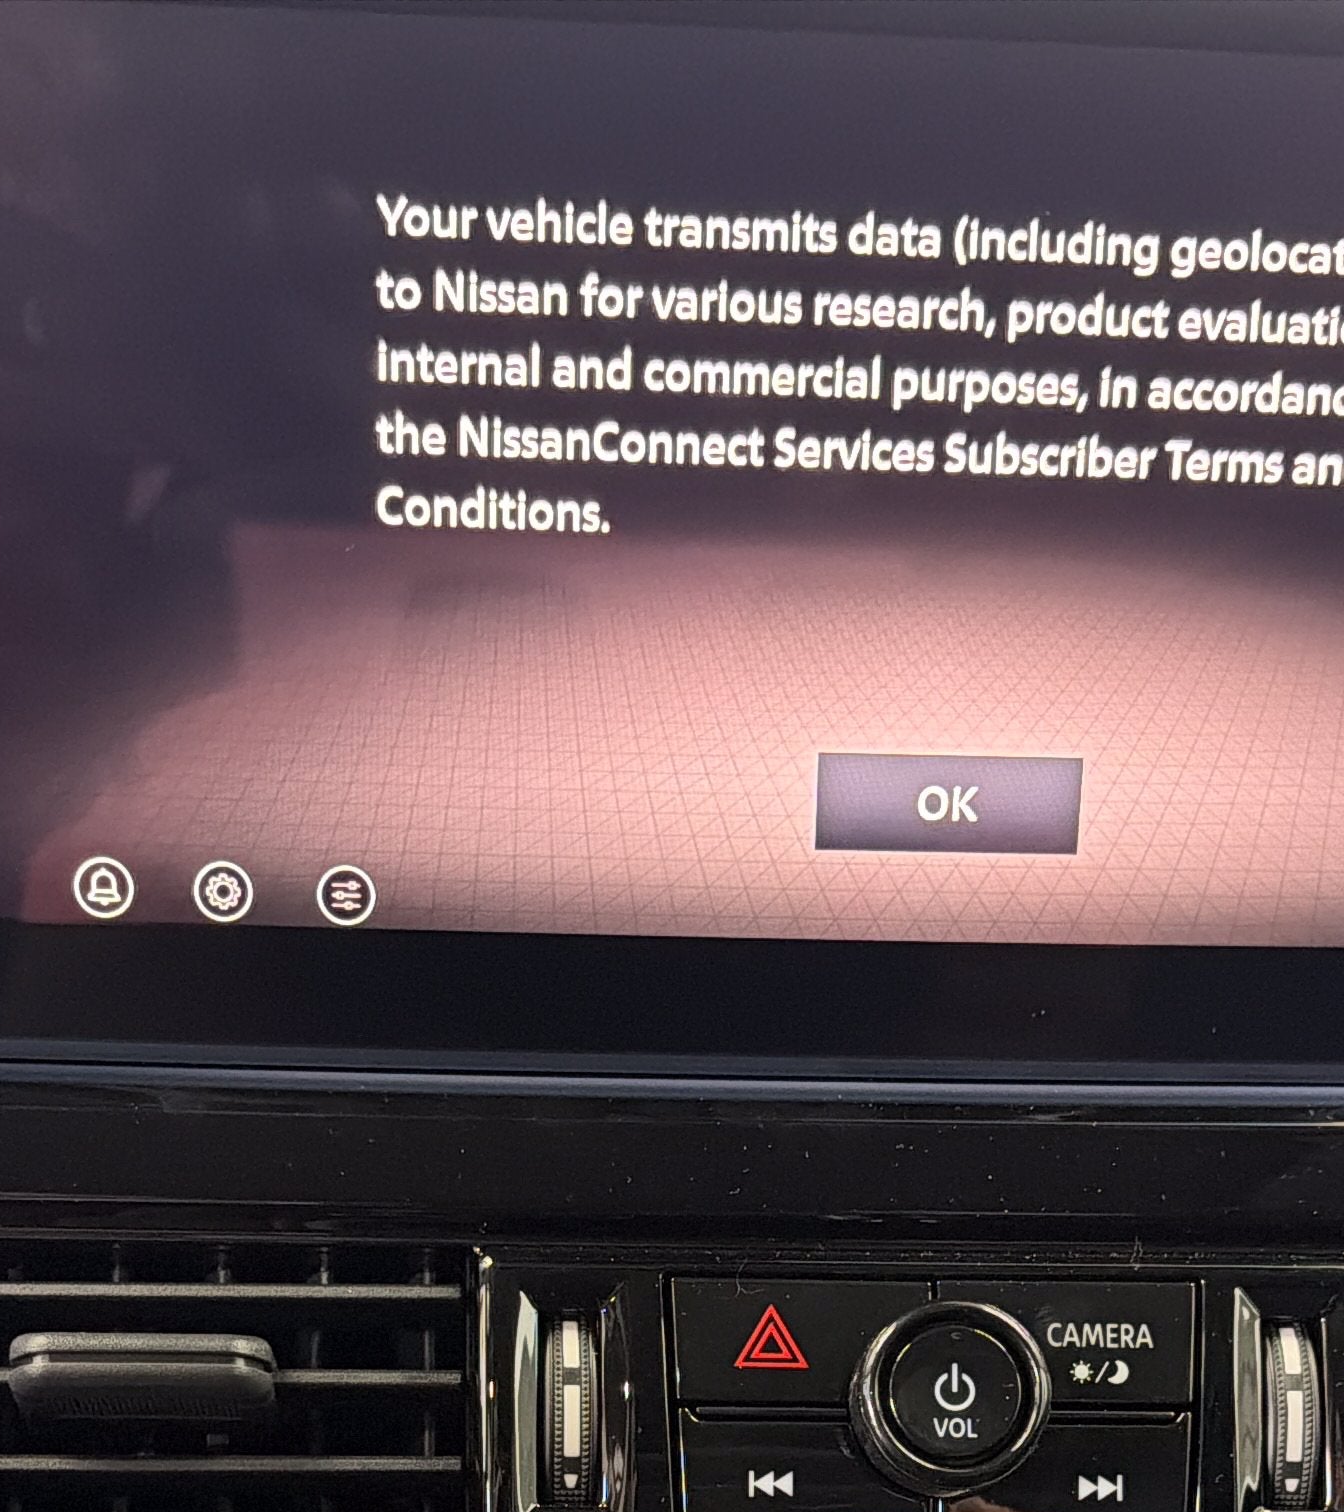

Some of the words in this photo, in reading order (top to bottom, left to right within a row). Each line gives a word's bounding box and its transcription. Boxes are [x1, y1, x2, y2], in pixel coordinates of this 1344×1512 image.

[376, 193, 479, 240] Your
[485, 197, 634, 245] vehicle
[643, 207, 838, 254] transmits
[847, 210, 942, 259] data
[954, 214, 1161, 277] (including
[375, 269, 422, 310] to
[434, 268, 568, 316] Nissan
[579, 271, 645, 319] for
[651, 279, 803, 325] various
[813, 286, 996, 339] research,
[1007, 291, 1171, 344] product
[377, 339, 541, 388] internal
[552, 345, 633, 391] and
[643, 354, 882, 400] commercial
[892, 367, 1089, 414] purposes,
[1099, 366, 1138, 409] in
[375, 409, 447, 456] the
[459, 414, 765, 468] NissanConnect
[773, 426, 935, 473] Services
[943, 430, 1159, 480] Subscriber
[1164, 439, 1285, 484] Terms
[376, 485, 611, 534] Conditions.
[917, 785, 979, 822] OK
[1046, 1322, 1154, 1349] CAMERA
[933, 1417, 978, 1438] VOL
